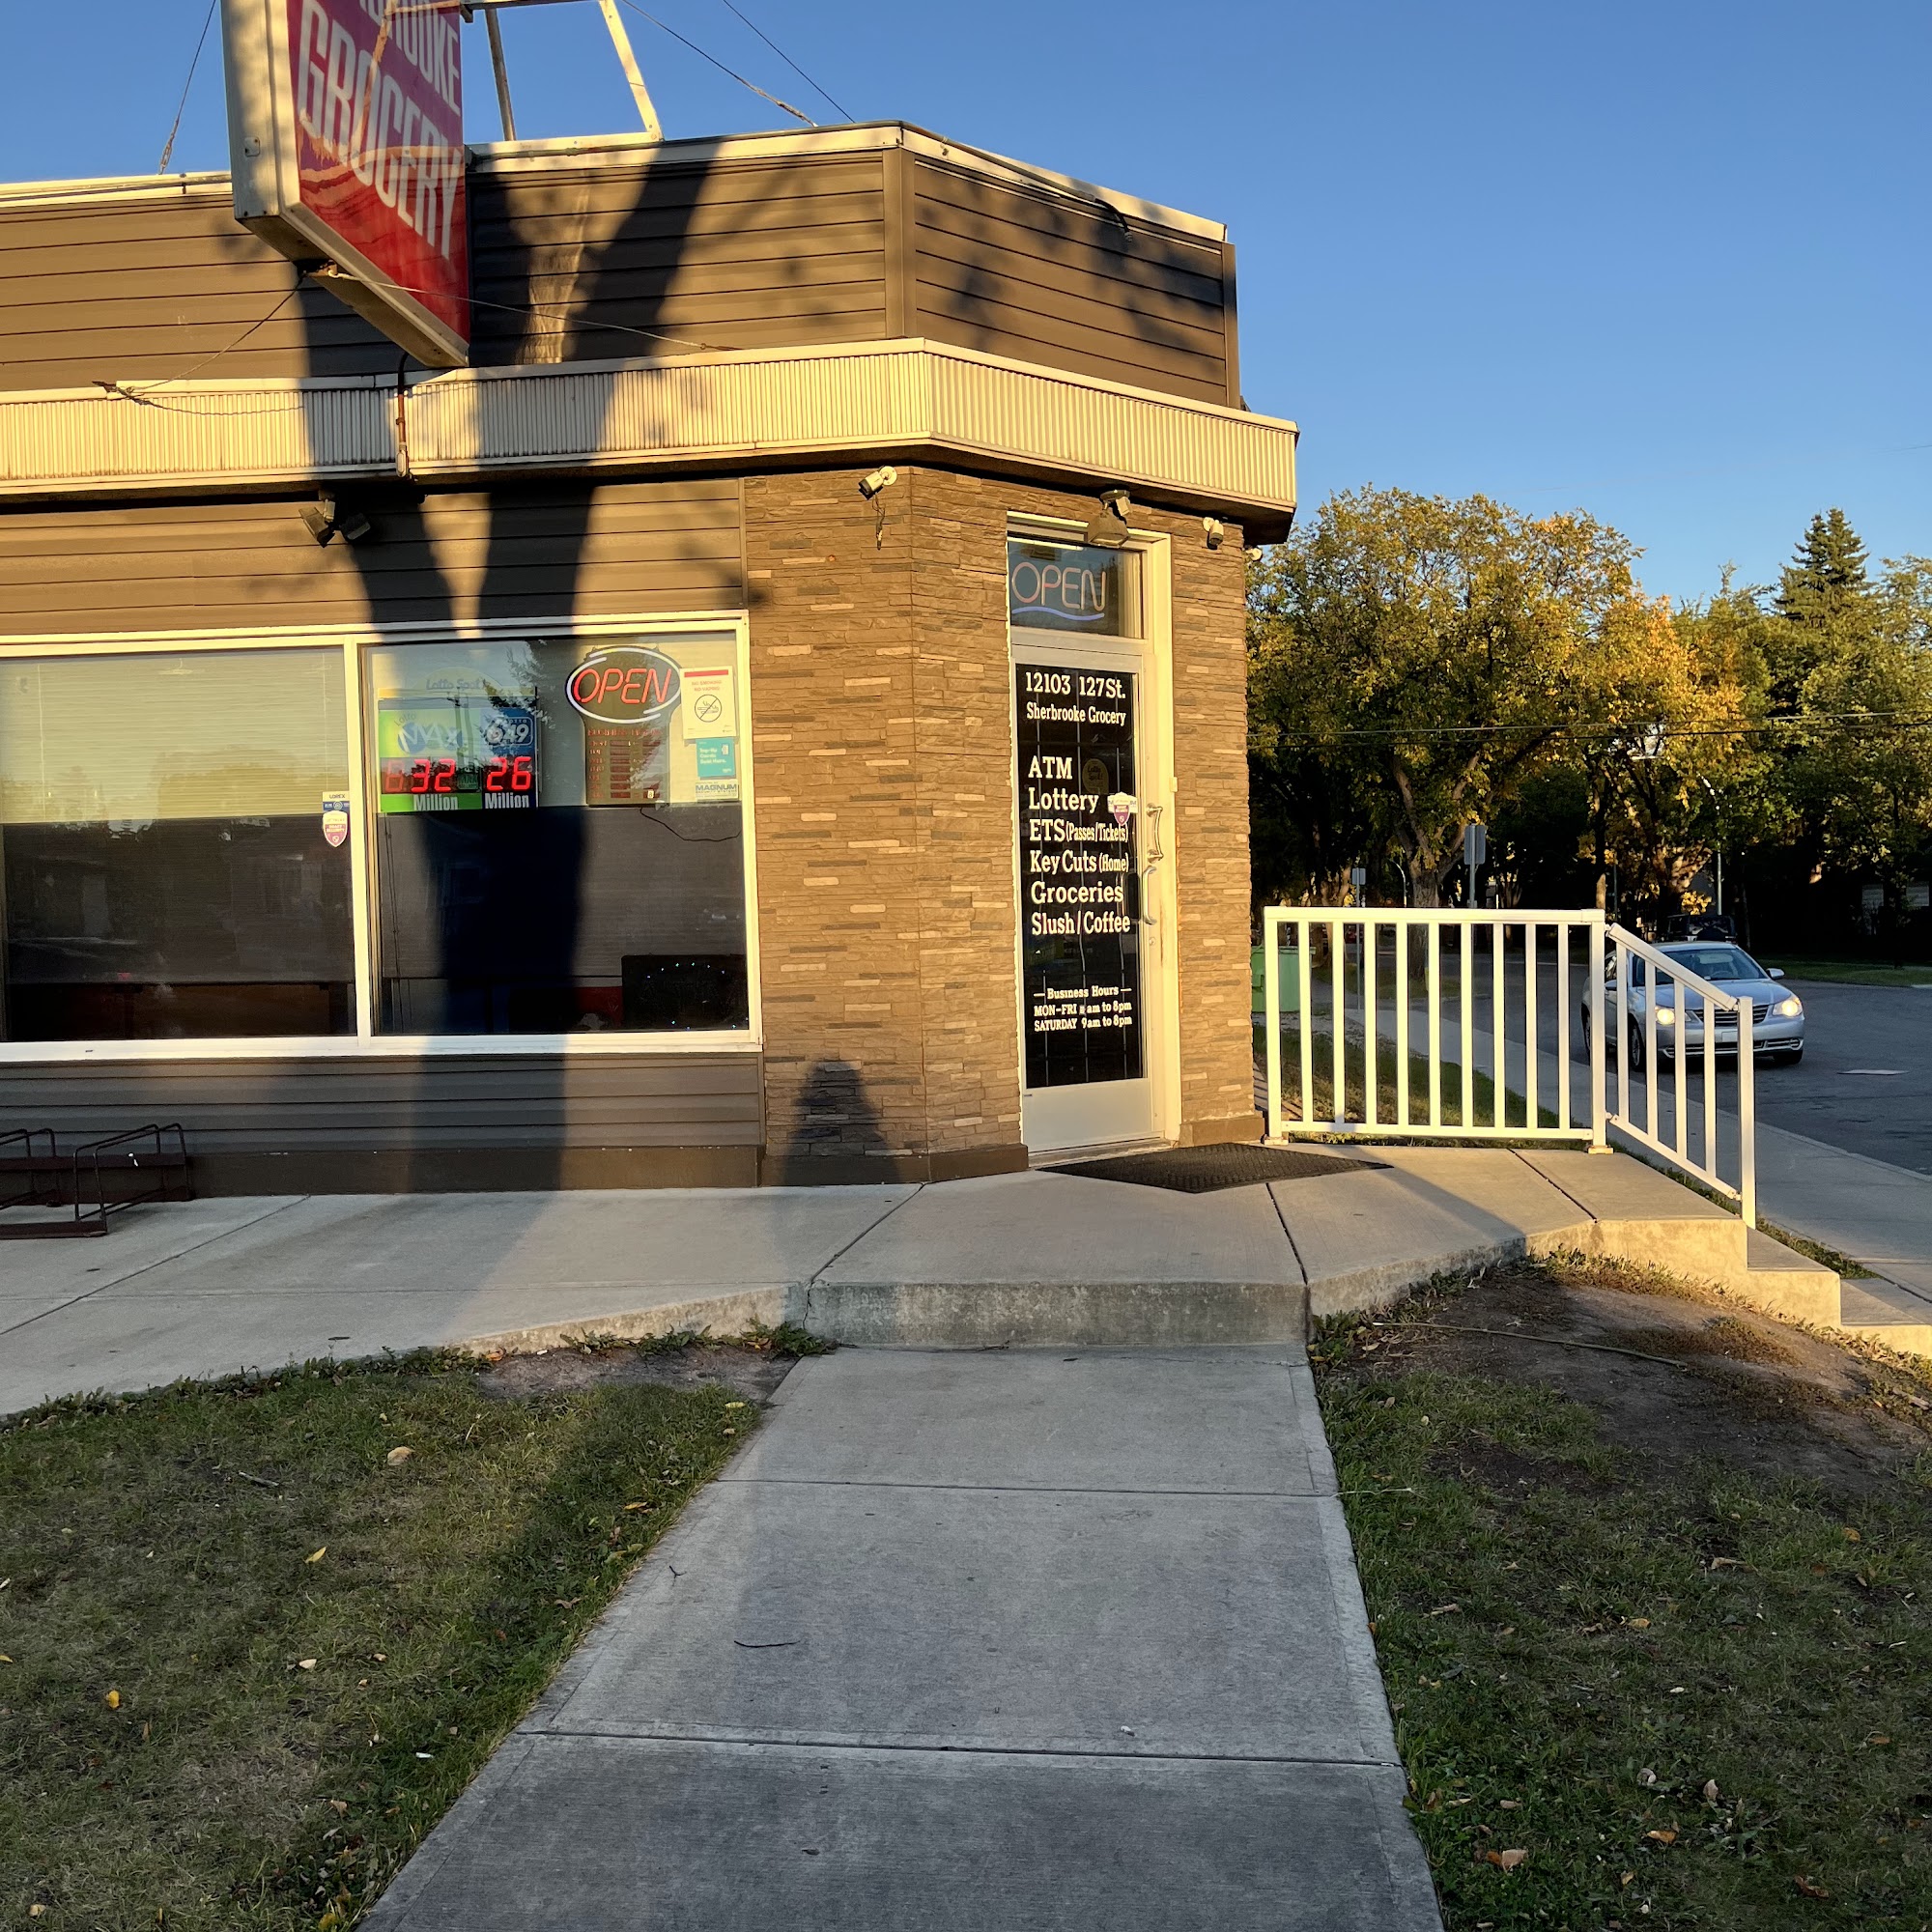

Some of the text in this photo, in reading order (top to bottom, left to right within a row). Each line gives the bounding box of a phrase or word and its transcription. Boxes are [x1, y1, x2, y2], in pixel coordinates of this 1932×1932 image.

[298, 0, 462, 260] GROCERY
[1011, 561, 1106, 611] OPEN
[573, 668, 672, 704] OPEN
[1025, 671, 1071, 696] 12103
[1026, 700, 1126, 727] Sherbrooke Grocery
[487, 756, 531, 791] 26
[1028, 755, 1073, 780] ATM
[413, 793, 458, 811] Million
[484, 792, 529, 810] Million
[1029, 786, 1099, 813] Lottery
[1030, 849, 1129, 875] Key Cuts (Home)
[1031, 880, 1124, 904] Groceries
[1047, 985, 1120, 1000] Business Hours
[1034, 1003, 1077, 1016] MON-FRI
[1102, 1001, 1112, 1012] to
[1034, 1017, 1078, 1032] SATURDAY
[1102, 1015, 1112, 1027] to
